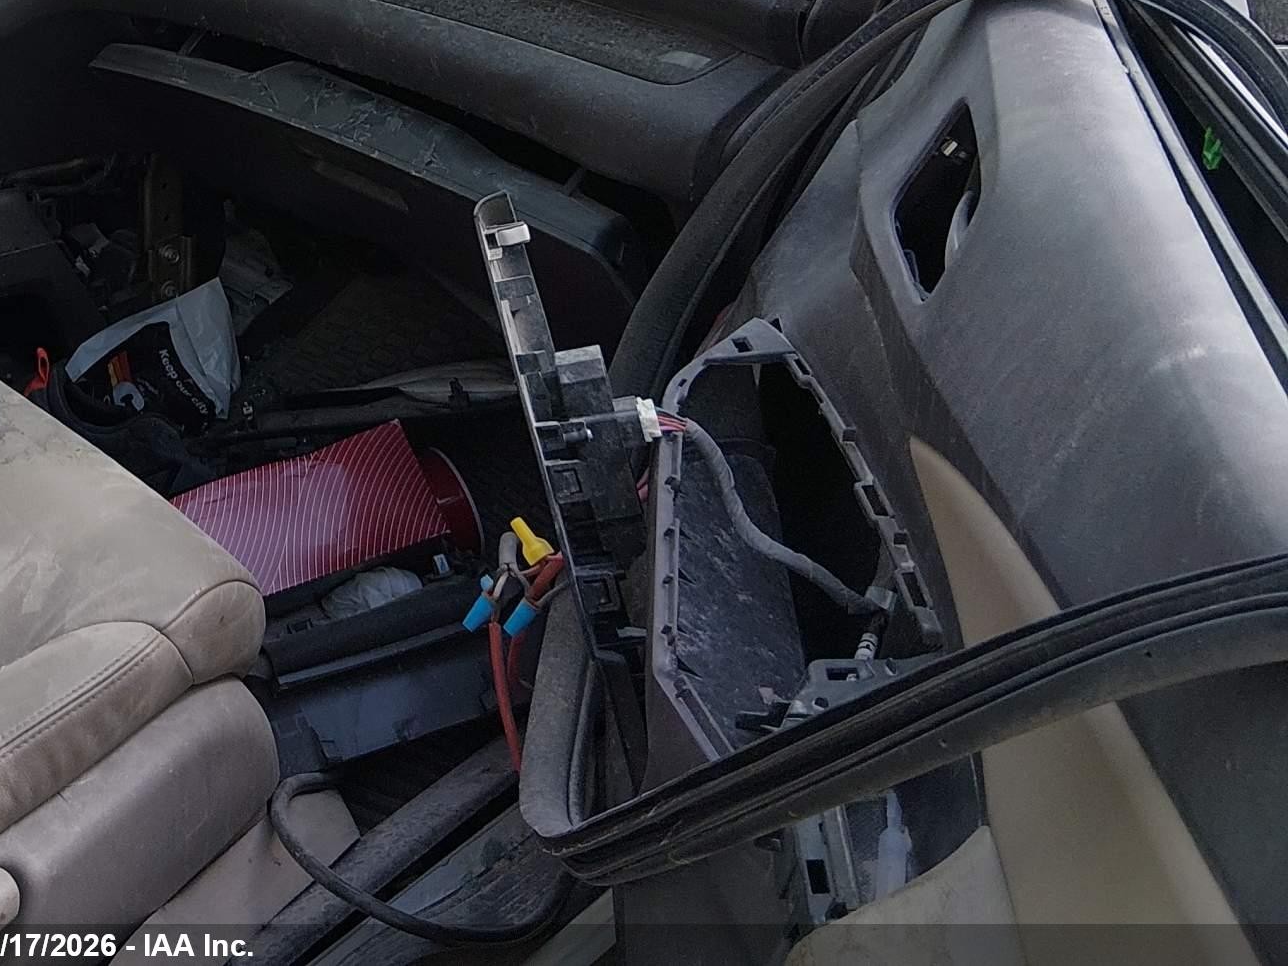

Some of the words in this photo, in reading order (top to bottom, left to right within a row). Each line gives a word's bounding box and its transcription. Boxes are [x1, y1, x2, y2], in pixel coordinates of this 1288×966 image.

[159, 349, 178, 379] Keep
[176, 380, 193, 397] our
[192, 397, 208, 415] city
